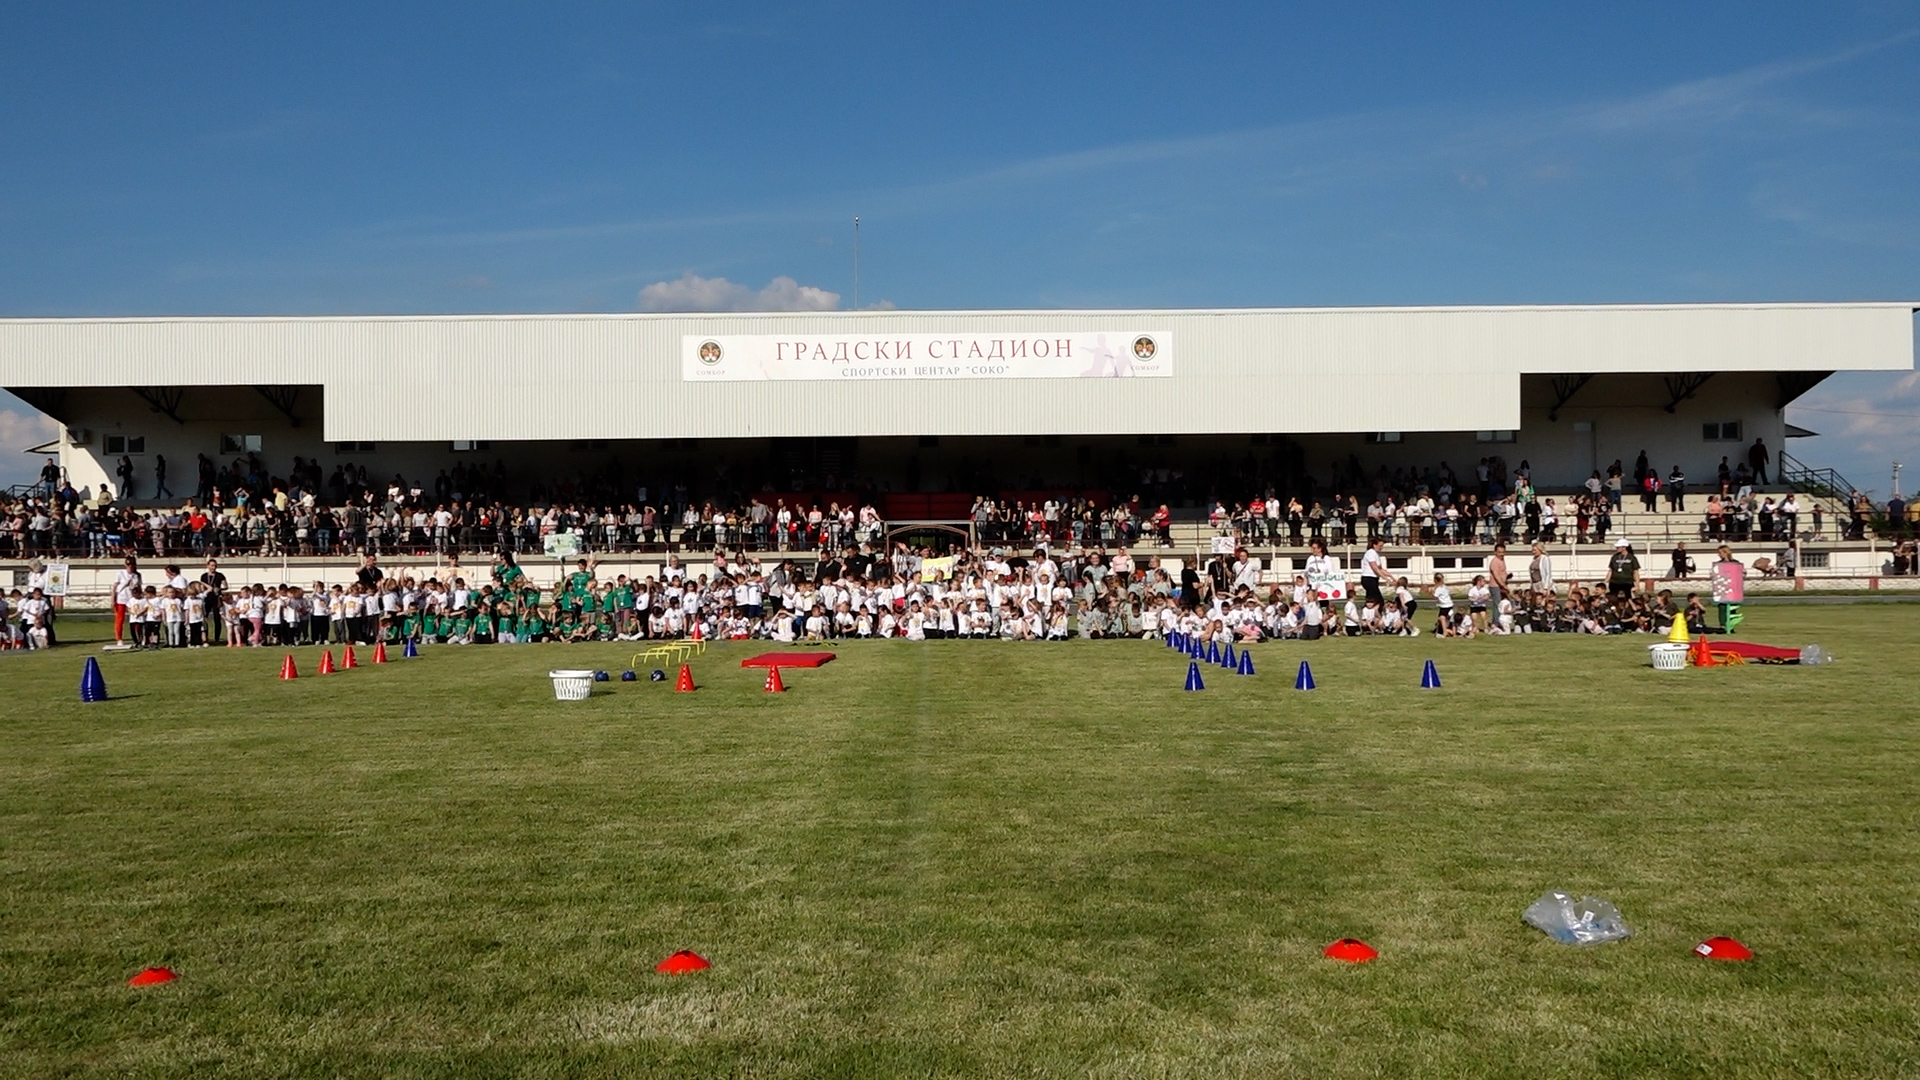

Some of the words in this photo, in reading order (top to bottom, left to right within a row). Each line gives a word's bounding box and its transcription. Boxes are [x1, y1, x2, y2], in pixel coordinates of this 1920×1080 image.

[776, 341, 913, 364] ГРАДСКИ
[928, 339, 1073, 362] СТАДИОН
[842, 367, 907, 377] СПОРТСКИ
[914, 366, 960, 376] ЦЕНТАР
[966, 365, 1010, 375] "СОКО"
